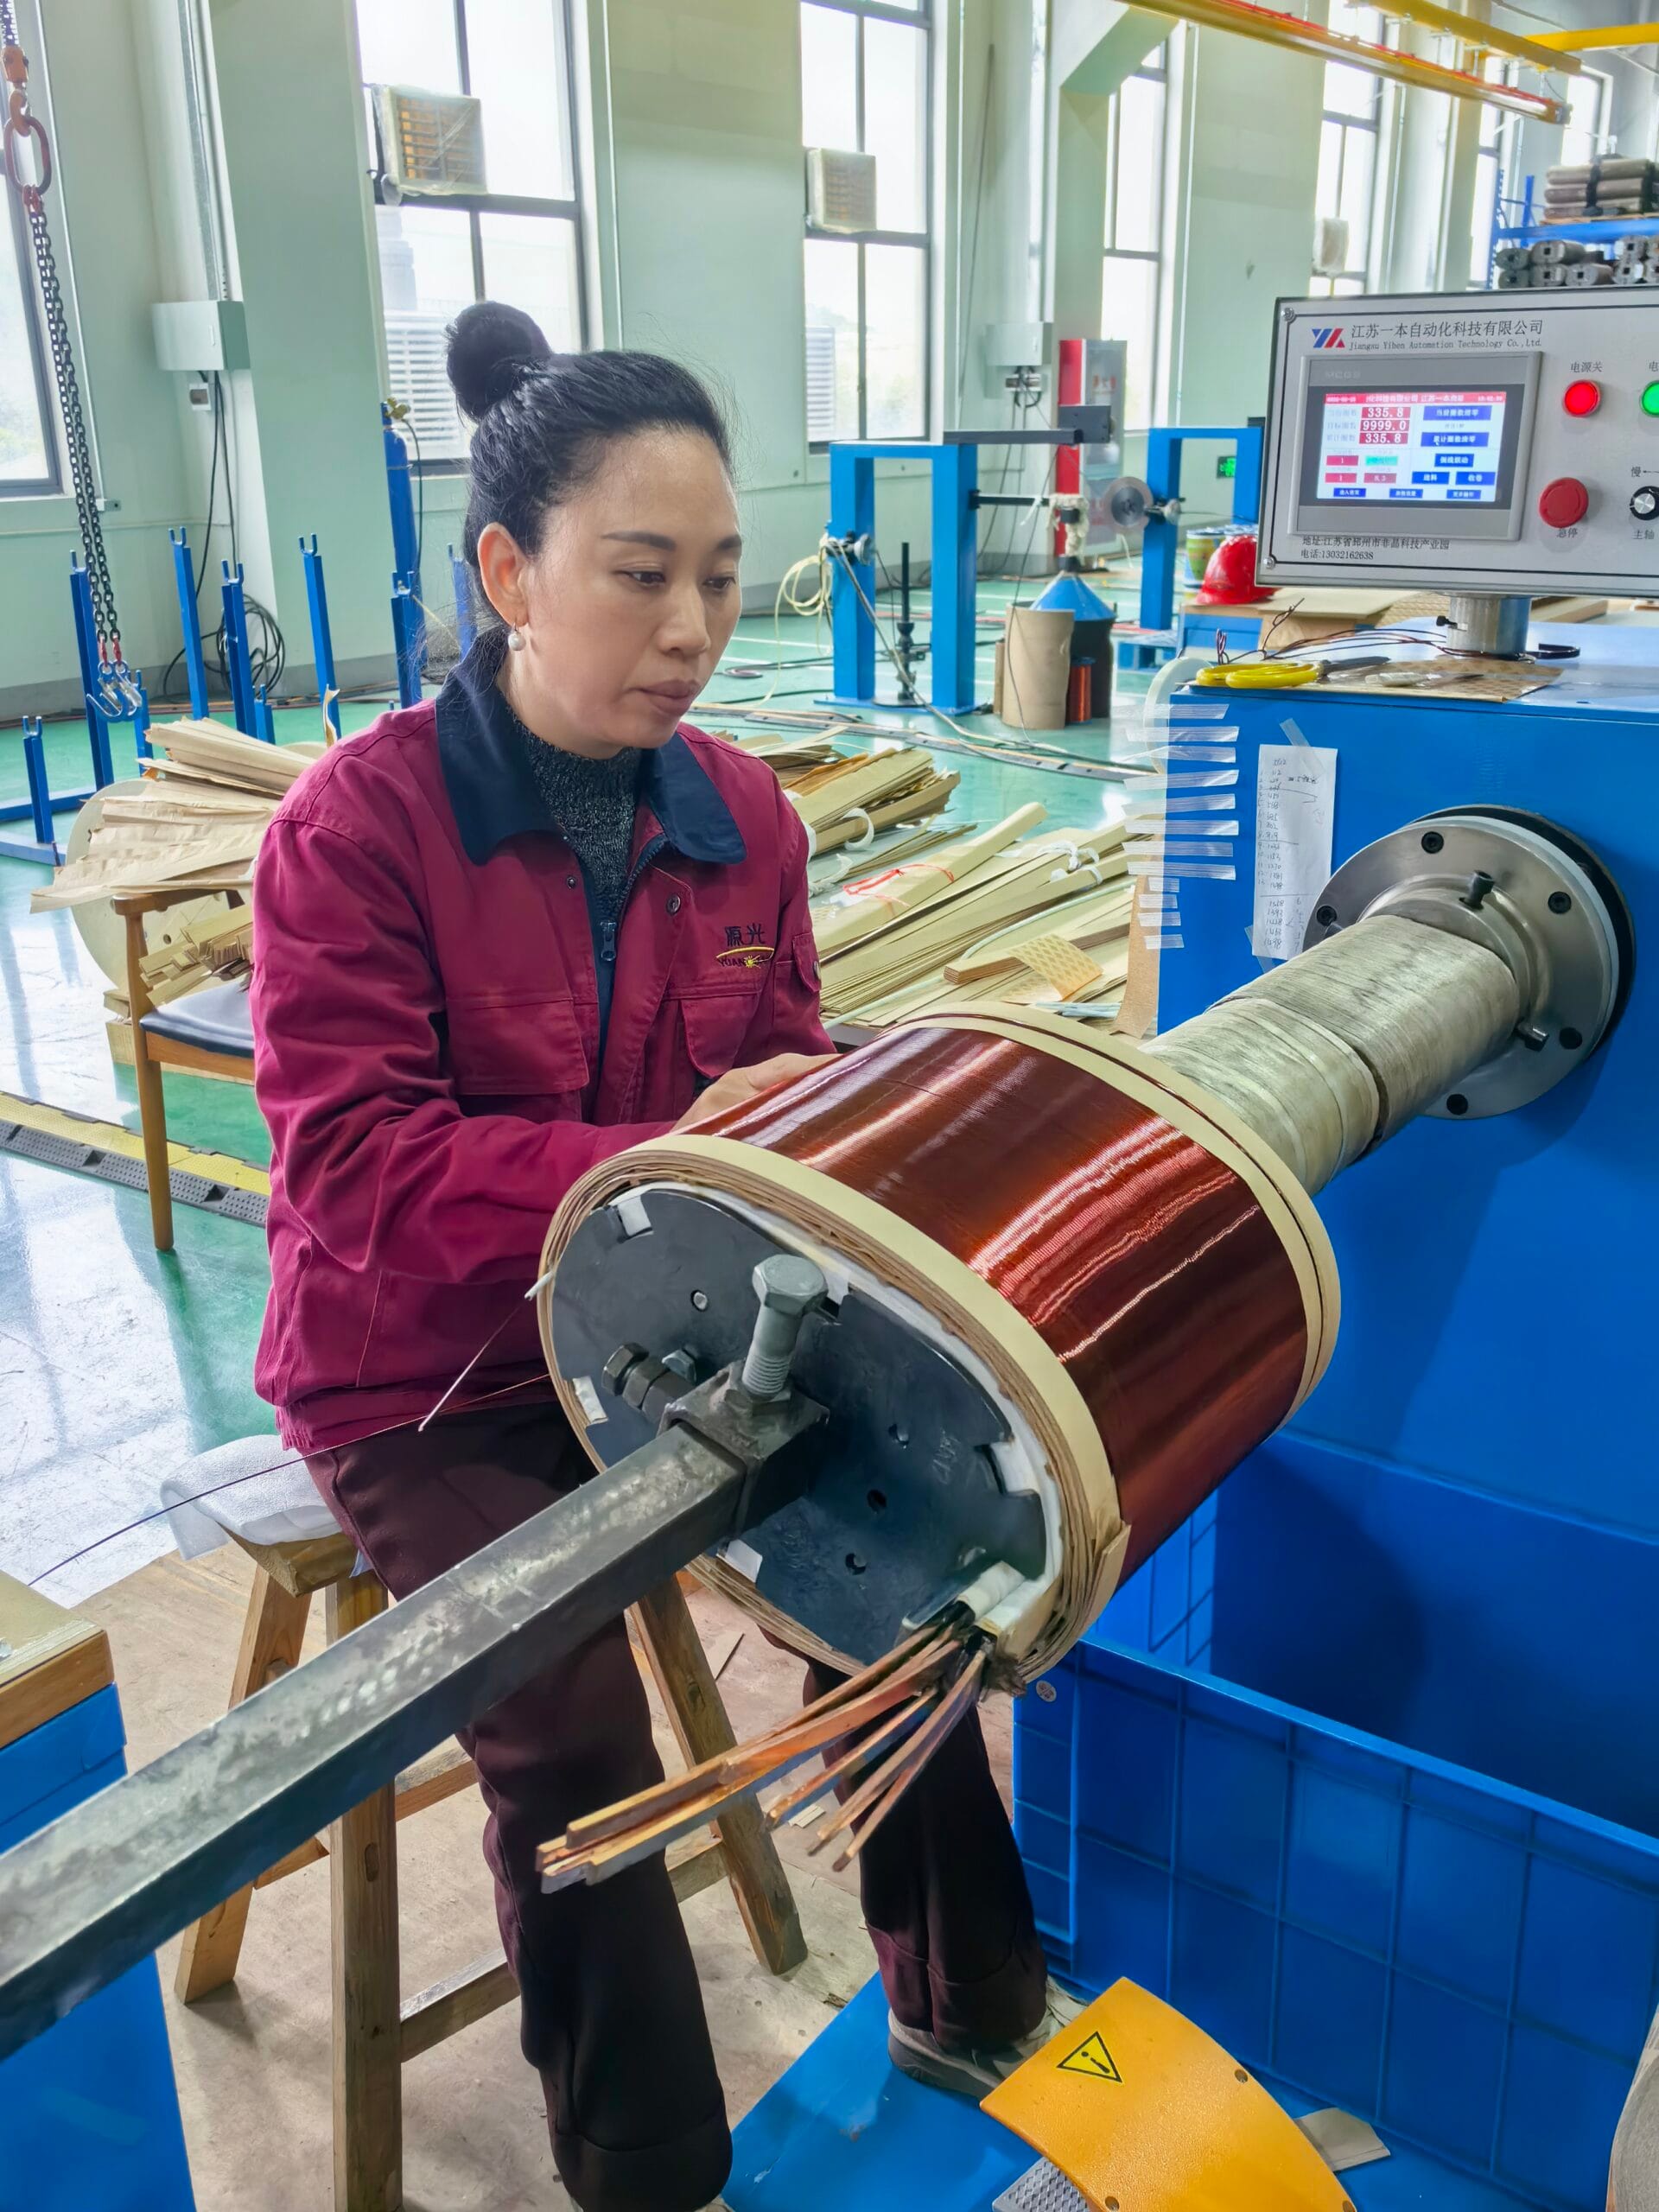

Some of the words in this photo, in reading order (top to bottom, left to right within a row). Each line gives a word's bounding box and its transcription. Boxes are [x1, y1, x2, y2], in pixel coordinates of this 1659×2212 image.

[1351, 320, 1542, 339] 江苏一本自动化科技有限公司
[1349, 341, 1379, 351] Jiangsu
[1409, 339, 1453, 348] Automation
[1459, 338, 1503, 348] Technology
[1570, 362, 1603, 373] 电源关
[1368, 407, 1404, 417] 335.8
[1363, 420, 1407, 431] 9999.0
[1365, 433, 1402, 443] 335.8
[1633, 529, 1655, 540] 主轴
